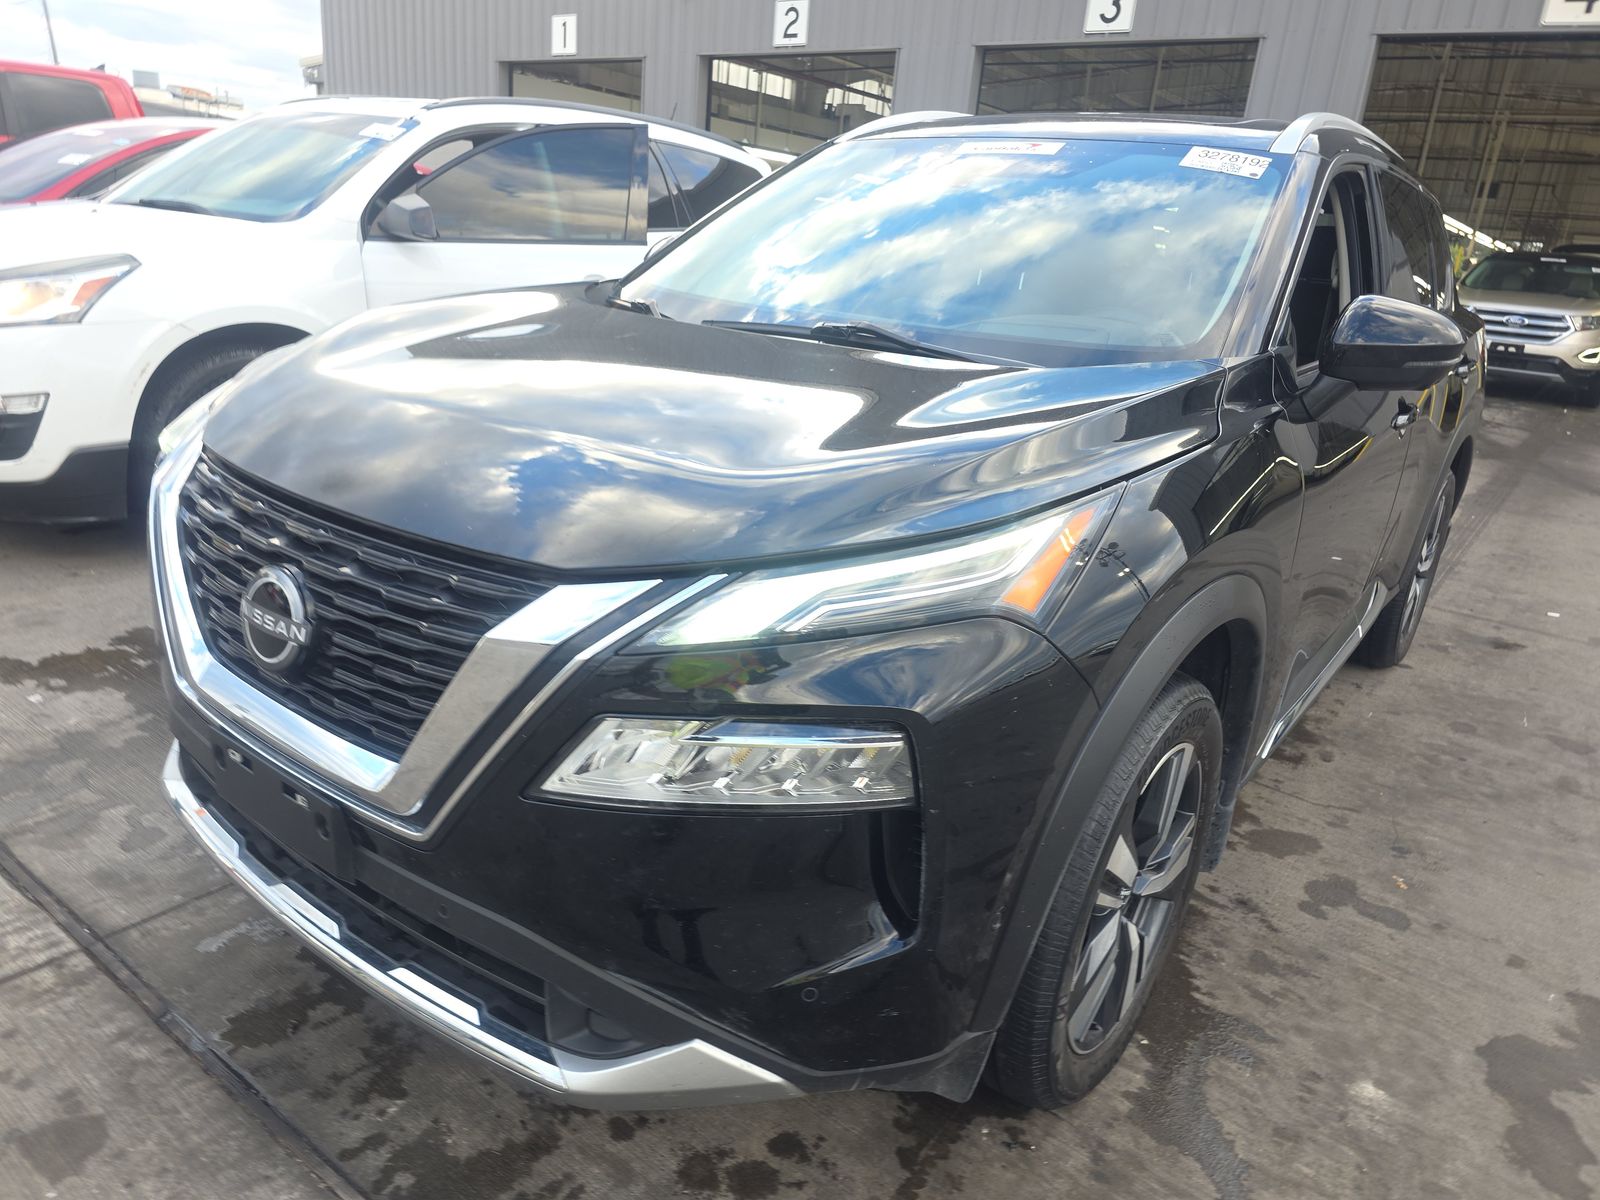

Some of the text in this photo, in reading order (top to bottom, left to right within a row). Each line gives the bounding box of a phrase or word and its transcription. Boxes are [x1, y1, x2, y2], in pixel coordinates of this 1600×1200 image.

[783, 6, 799, 38] 2
[1198, 149, 1270, 169] 3278192
[242, 600, 307, 643] SSAN
